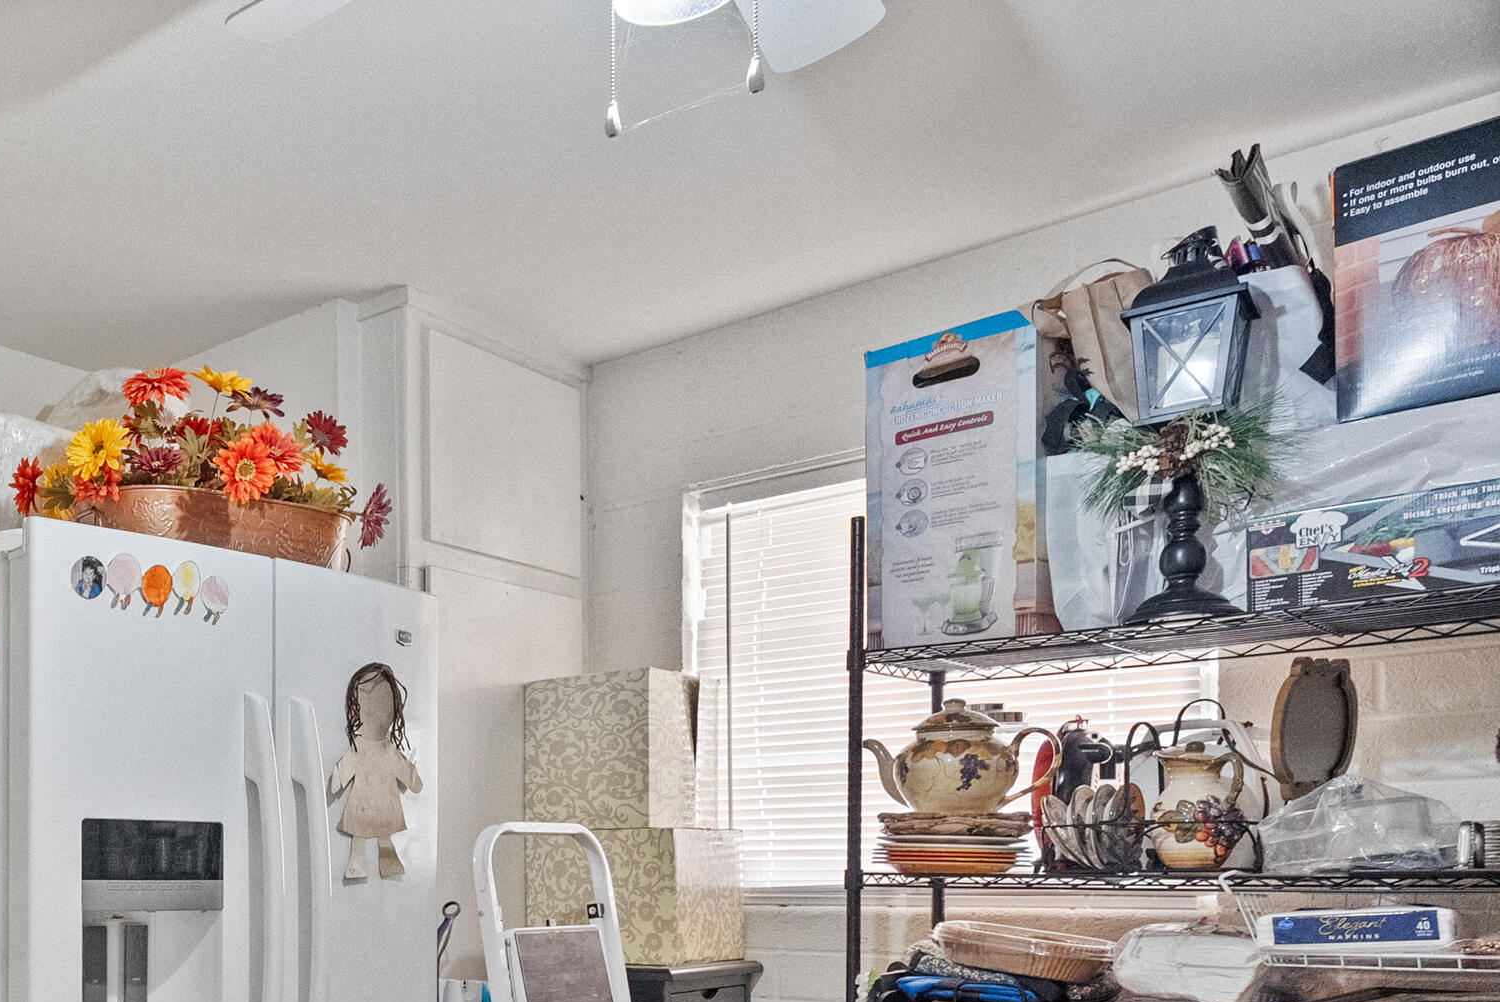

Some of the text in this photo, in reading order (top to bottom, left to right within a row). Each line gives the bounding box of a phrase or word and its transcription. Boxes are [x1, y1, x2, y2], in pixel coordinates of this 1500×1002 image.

[1350, 153, 1476, 198] For indoor and outdoor use
[1350, 198, 1357, 207] If
[1358, 194, 1375, 205] one
[1377, 190, 1388, 200] or
[1390, 182, 1414, 196] more
[1416, 173, 1443, 188] bulbs
[1445, 165, 1468, 179] burn
[1350, 187, 1429, 217] Easy to assemble
[974, 392, 1003, 407] MAKER
[901, 413, 989, 442] Quick And Easy Controls
[1434, 490, 1458, 501] Thick
[1461, 487, 1478, 497] and
[1436, 501, 1482, 515] Shredding
[1408, 556, 1432, 579] 2
[1318, 914, 1431, 936] Elegant 40
